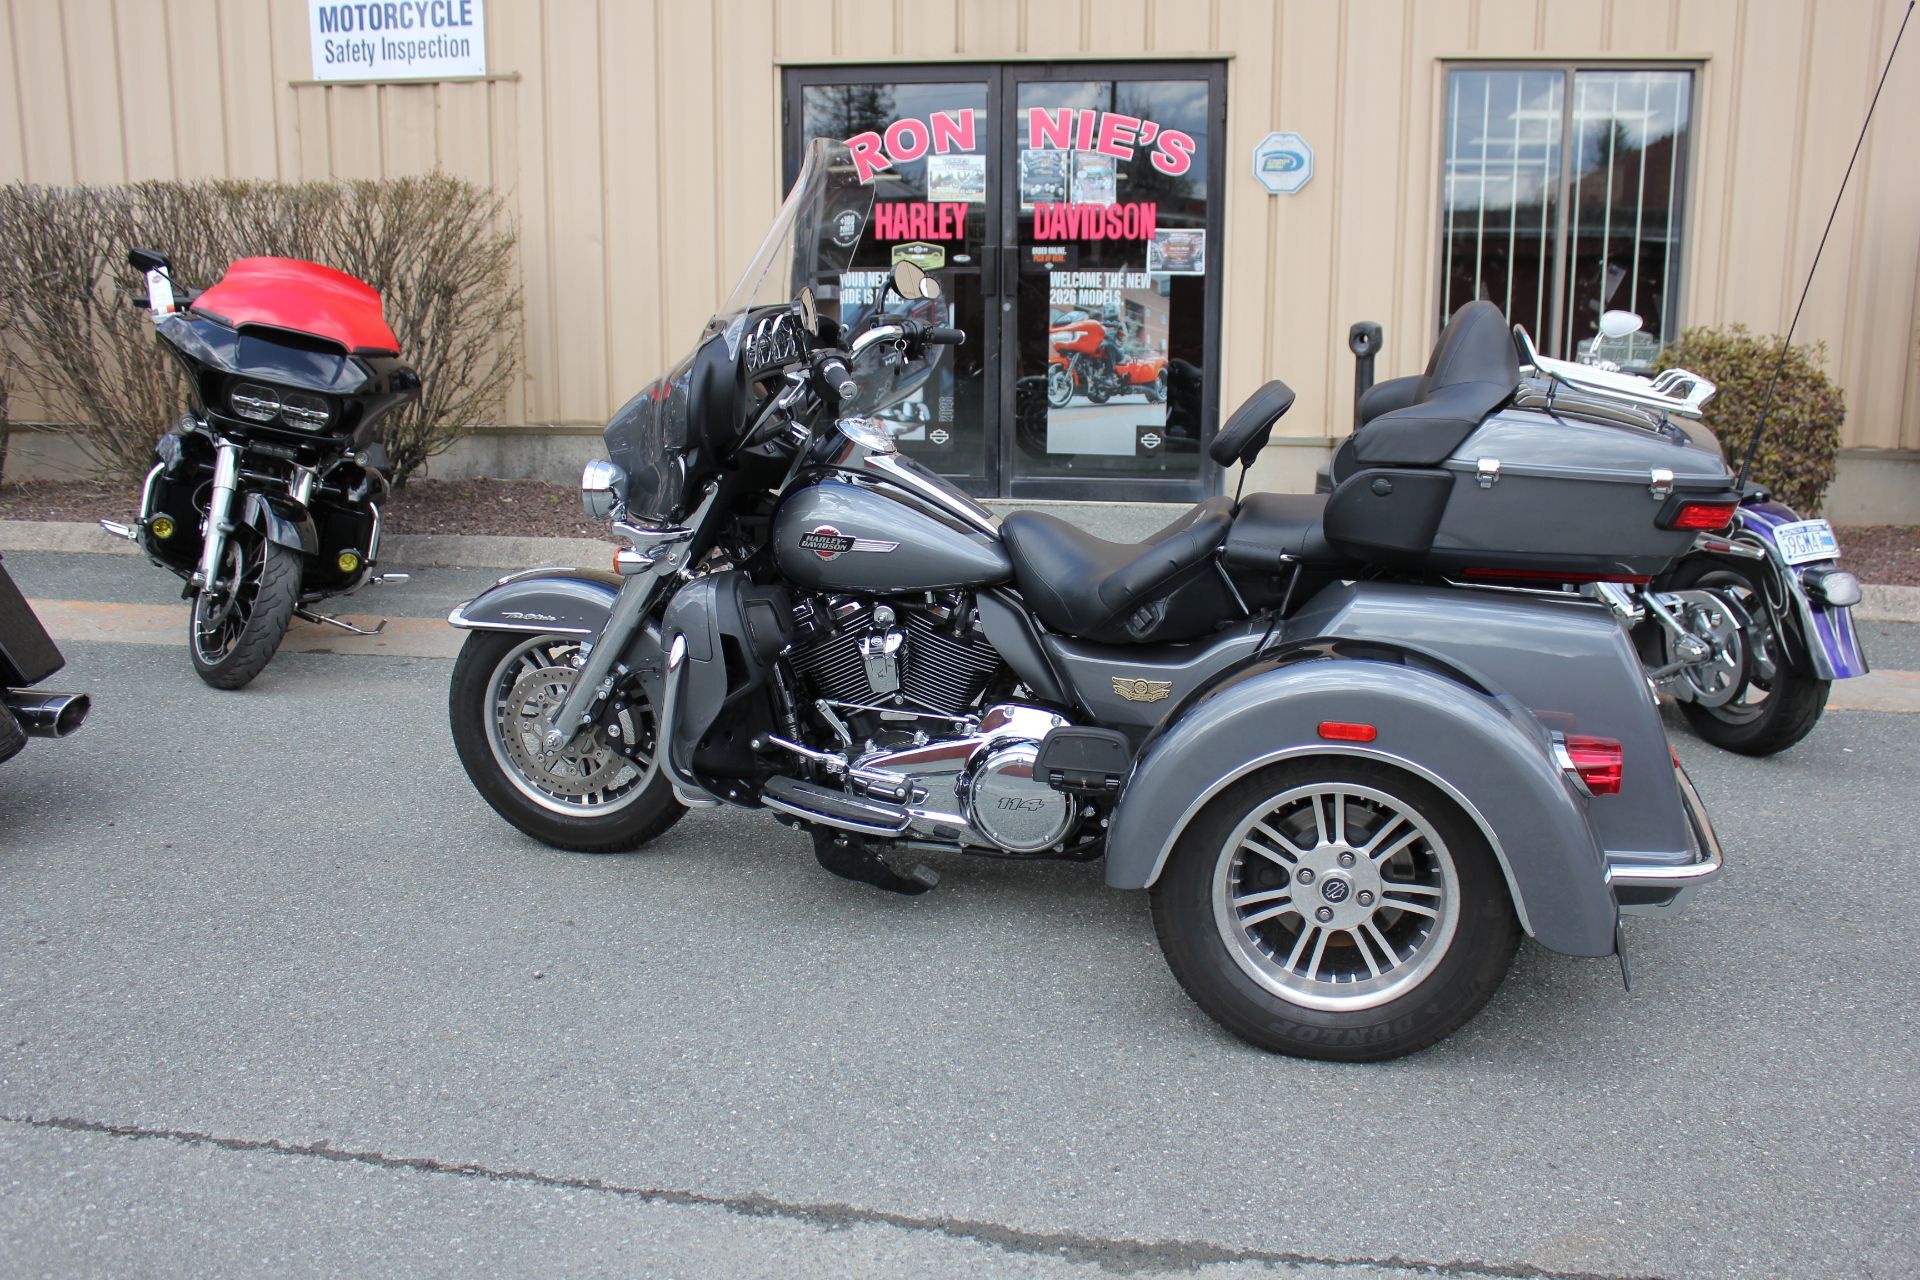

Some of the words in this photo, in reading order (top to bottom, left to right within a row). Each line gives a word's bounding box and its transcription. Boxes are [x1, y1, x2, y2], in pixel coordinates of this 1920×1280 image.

[319, 0, 473, 33] MOTORCYCLE
[325, 38, 376, 68] Safety
[381, 34, 471, 65] Inspection
[843, 108, 977, 185] RON
[1028, 107, 1197, 176] NIE'S
[875, 202, 968, 240] HARLEY
[1033, 202, 1157, 241] DAVIDSON
[1050, 271, 1102, 288] WELCOME
[1104, 271, 1124, 288] THE
[1126, 272, 1151, 289] NEW
[863, 288, 874, 304] IS
[1049, 288, 1076, 305] 2026
[1078, 289, 1124, 306] MODELS.
[801, 540, 848, 551] DAVIDSON
[805, 535, 847, 545] HARLEY-
[997, 797, 1045, 811] 114
[1267, 1014, 1414, 1043] DUNLOP
